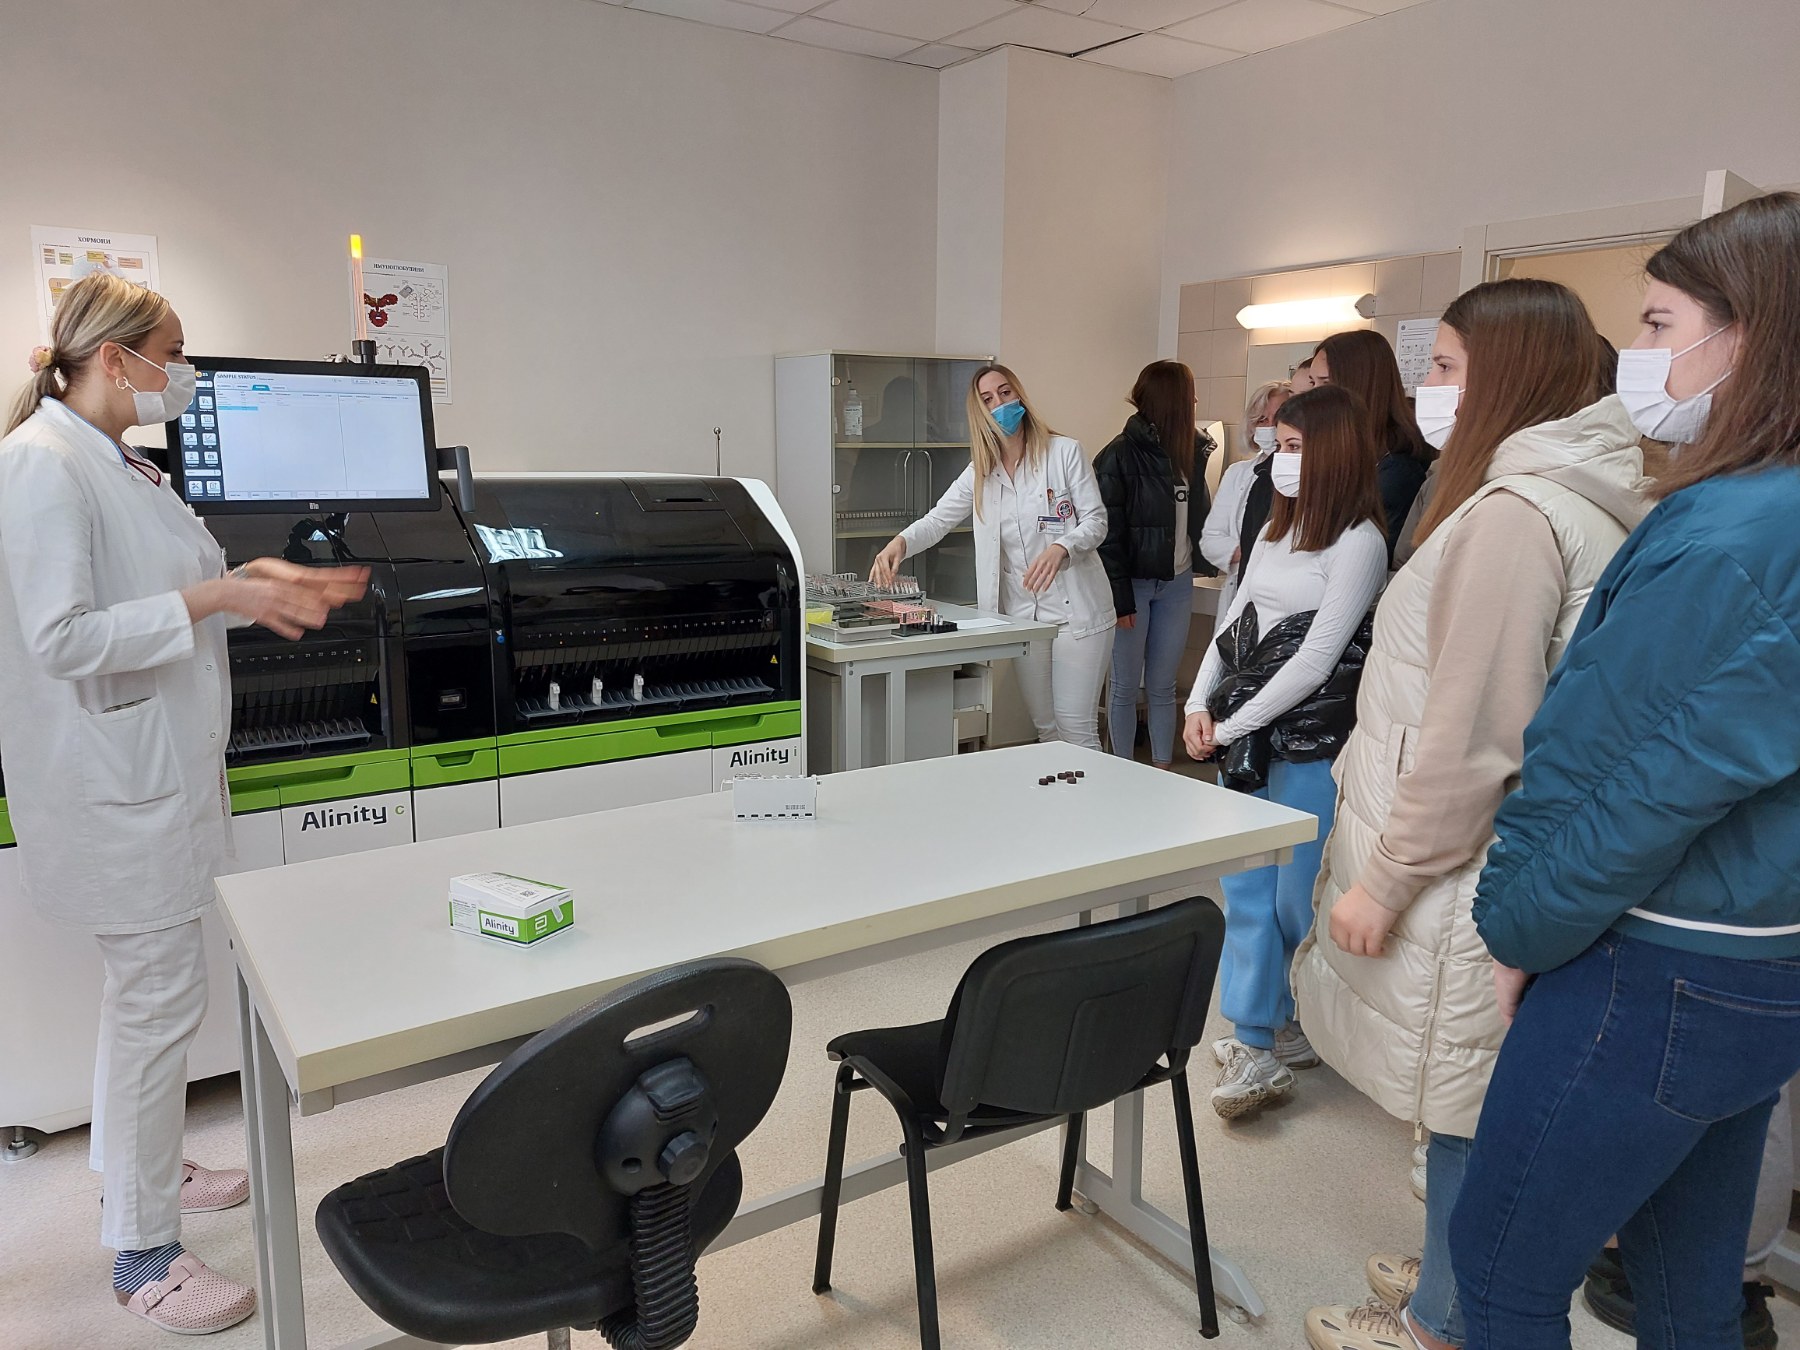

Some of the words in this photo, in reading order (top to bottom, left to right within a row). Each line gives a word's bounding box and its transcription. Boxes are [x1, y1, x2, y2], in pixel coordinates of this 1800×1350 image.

[730, 747, 788, 768] Alinity
[301, 805, 387, 831] Alinity
[485, 917, 515, 935] Alinity
